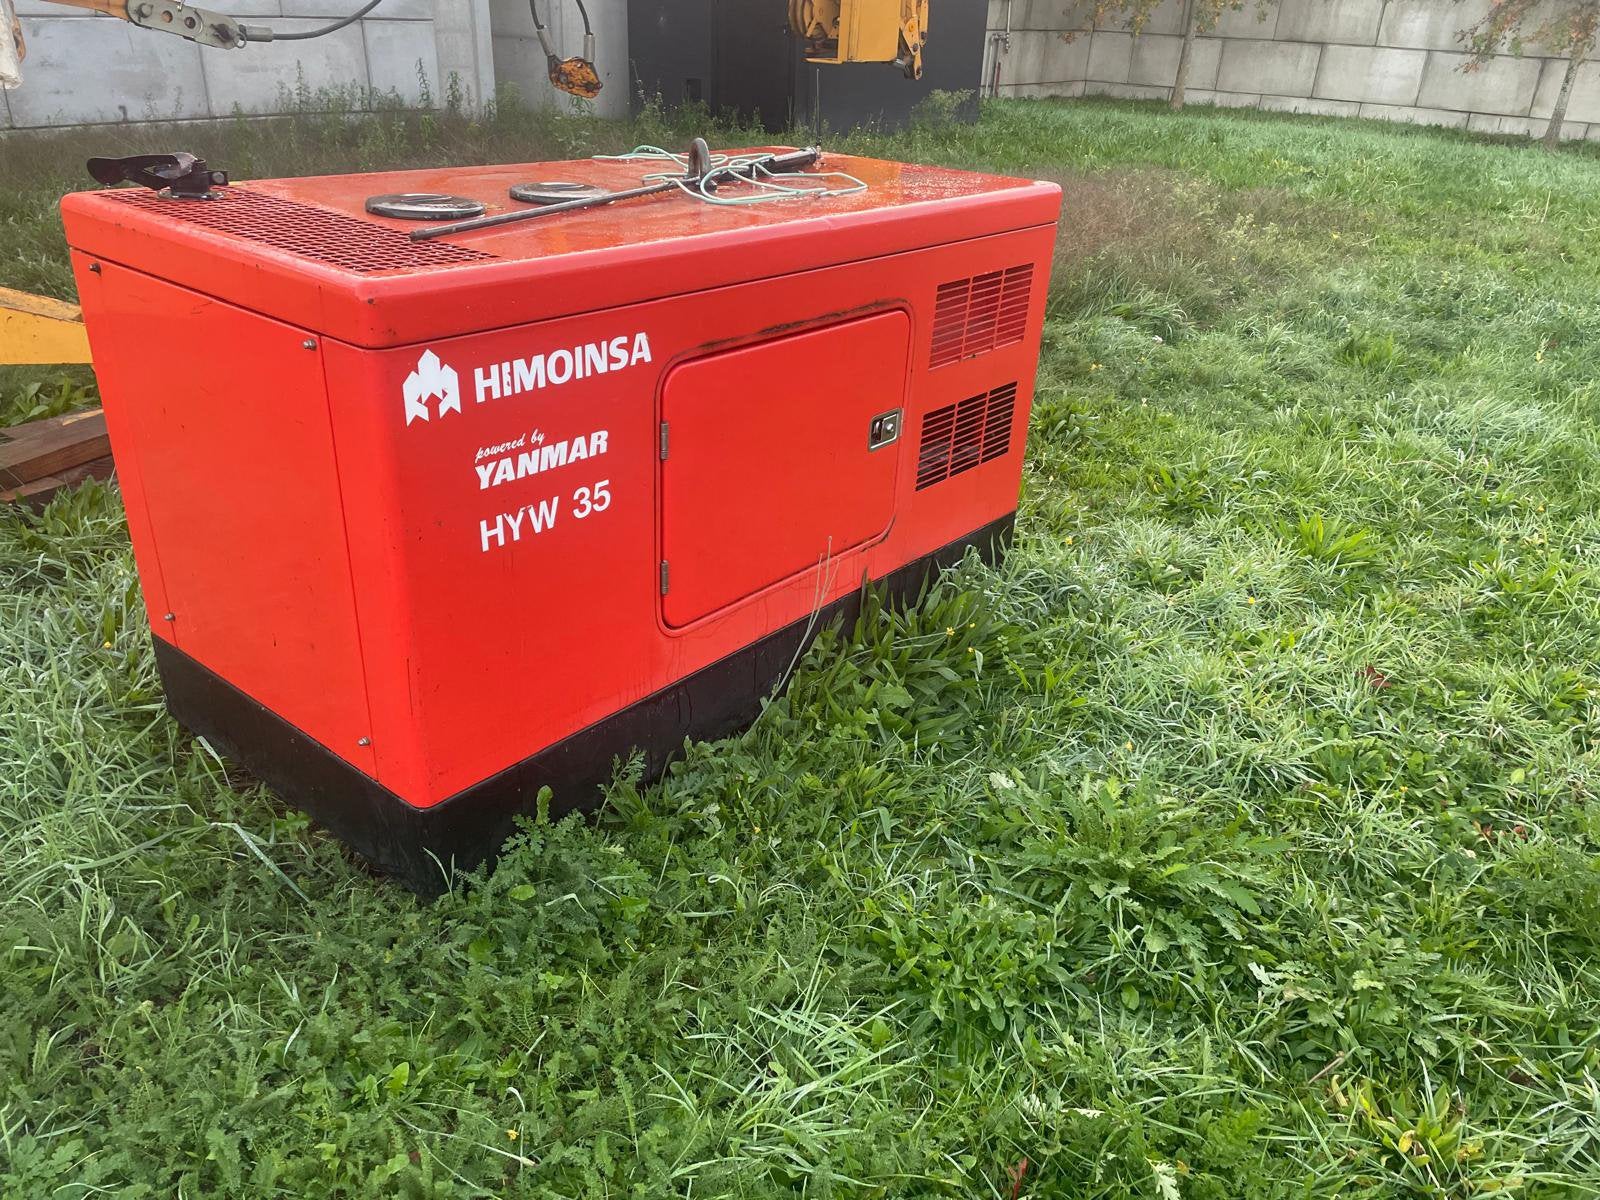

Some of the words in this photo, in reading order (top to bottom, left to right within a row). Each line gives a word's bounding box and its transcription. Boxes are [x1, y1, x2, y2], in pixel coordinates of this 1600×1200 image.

[474, 332, 651, 402] HIMOINSA
[475, 433, 525, 461] powered
[530, 428, 545, 445] by
[475, 430, 608, 489] YANMAR
[479, 496, 560, 552] HYW
[572, 479, 611, 519] 35
